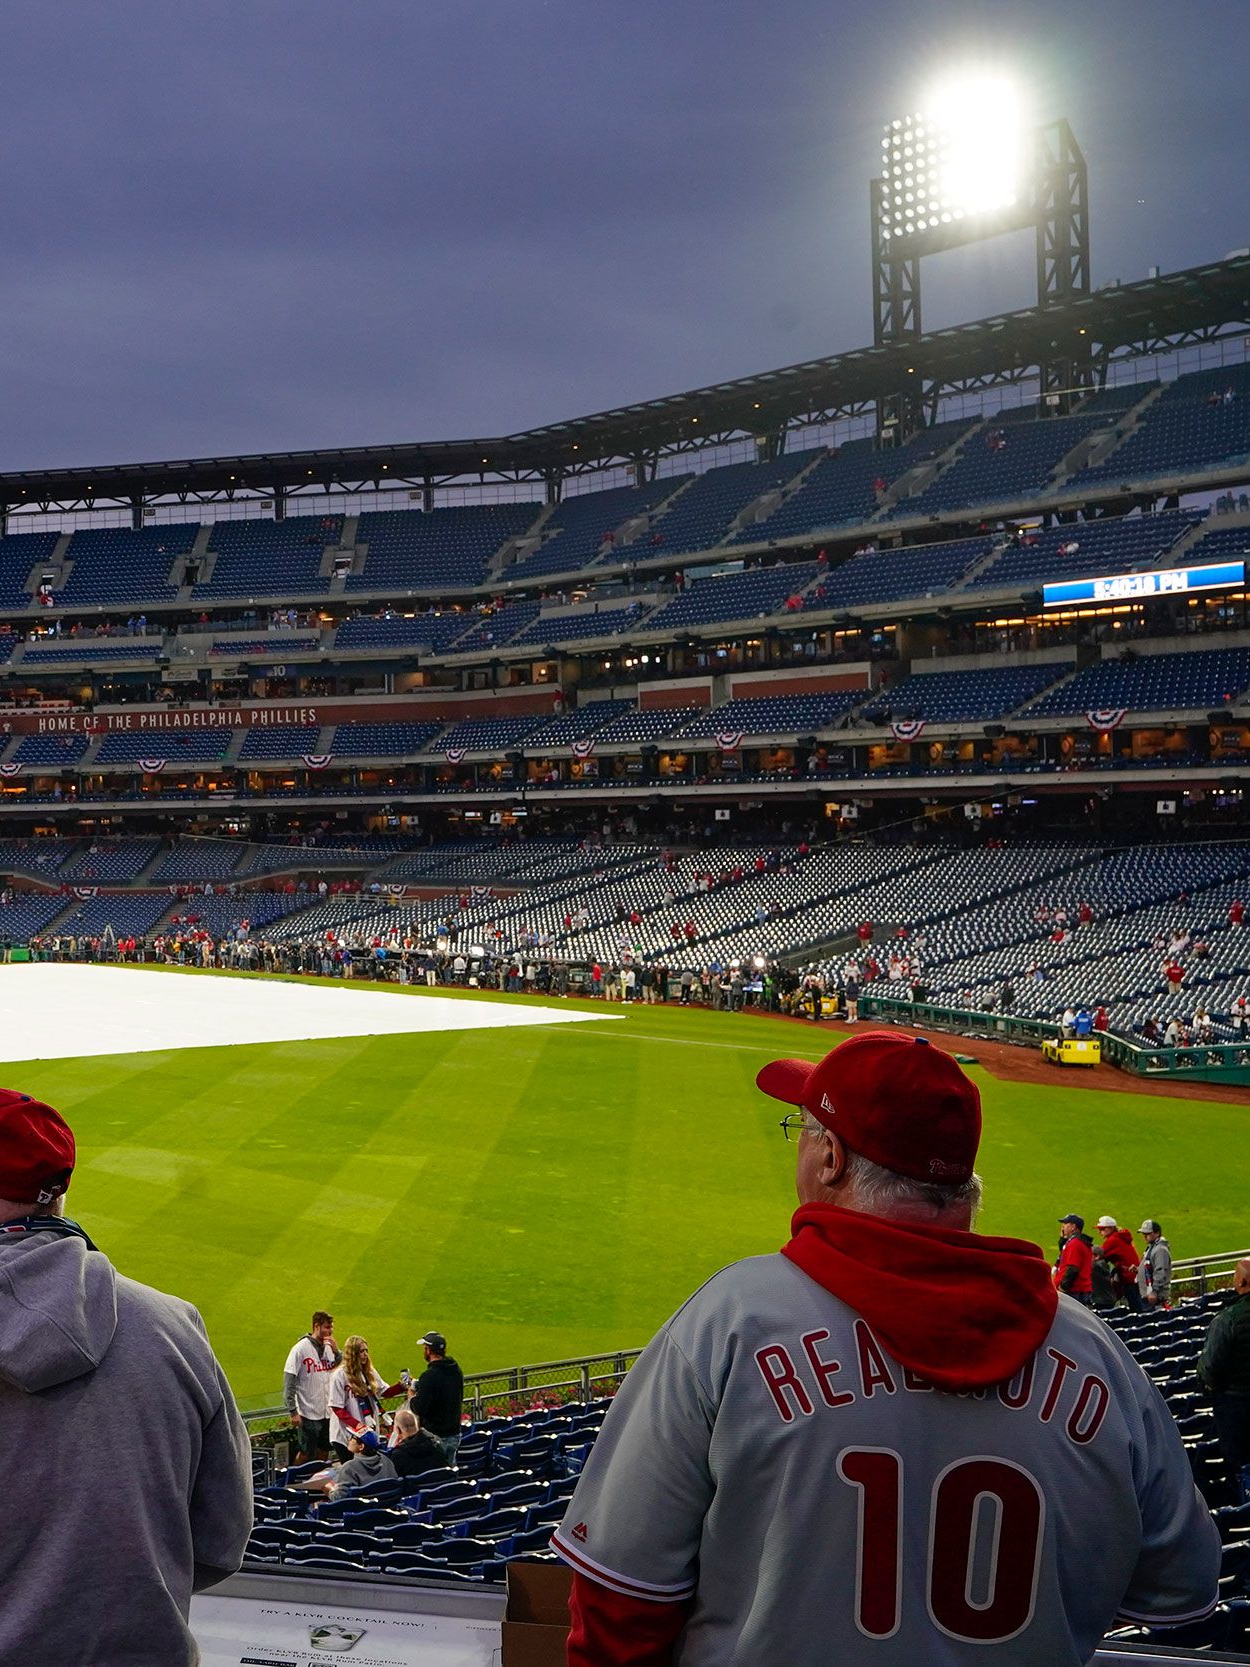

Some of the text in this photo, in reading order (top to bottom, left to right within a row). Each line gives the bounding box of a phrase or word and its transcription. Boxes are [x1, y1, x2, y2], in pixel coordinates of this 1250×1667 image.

[1160, 572, 1188, 592] PM
[39, 709, 316, 731] HOME OF THE PHILADELPHIA PHILLIES
[754, 1319, 1110, 1445] REALUTO
[835, 1445, 1046, 1645] 10
[328, 1615, 387, 1625] COCKTAIL
